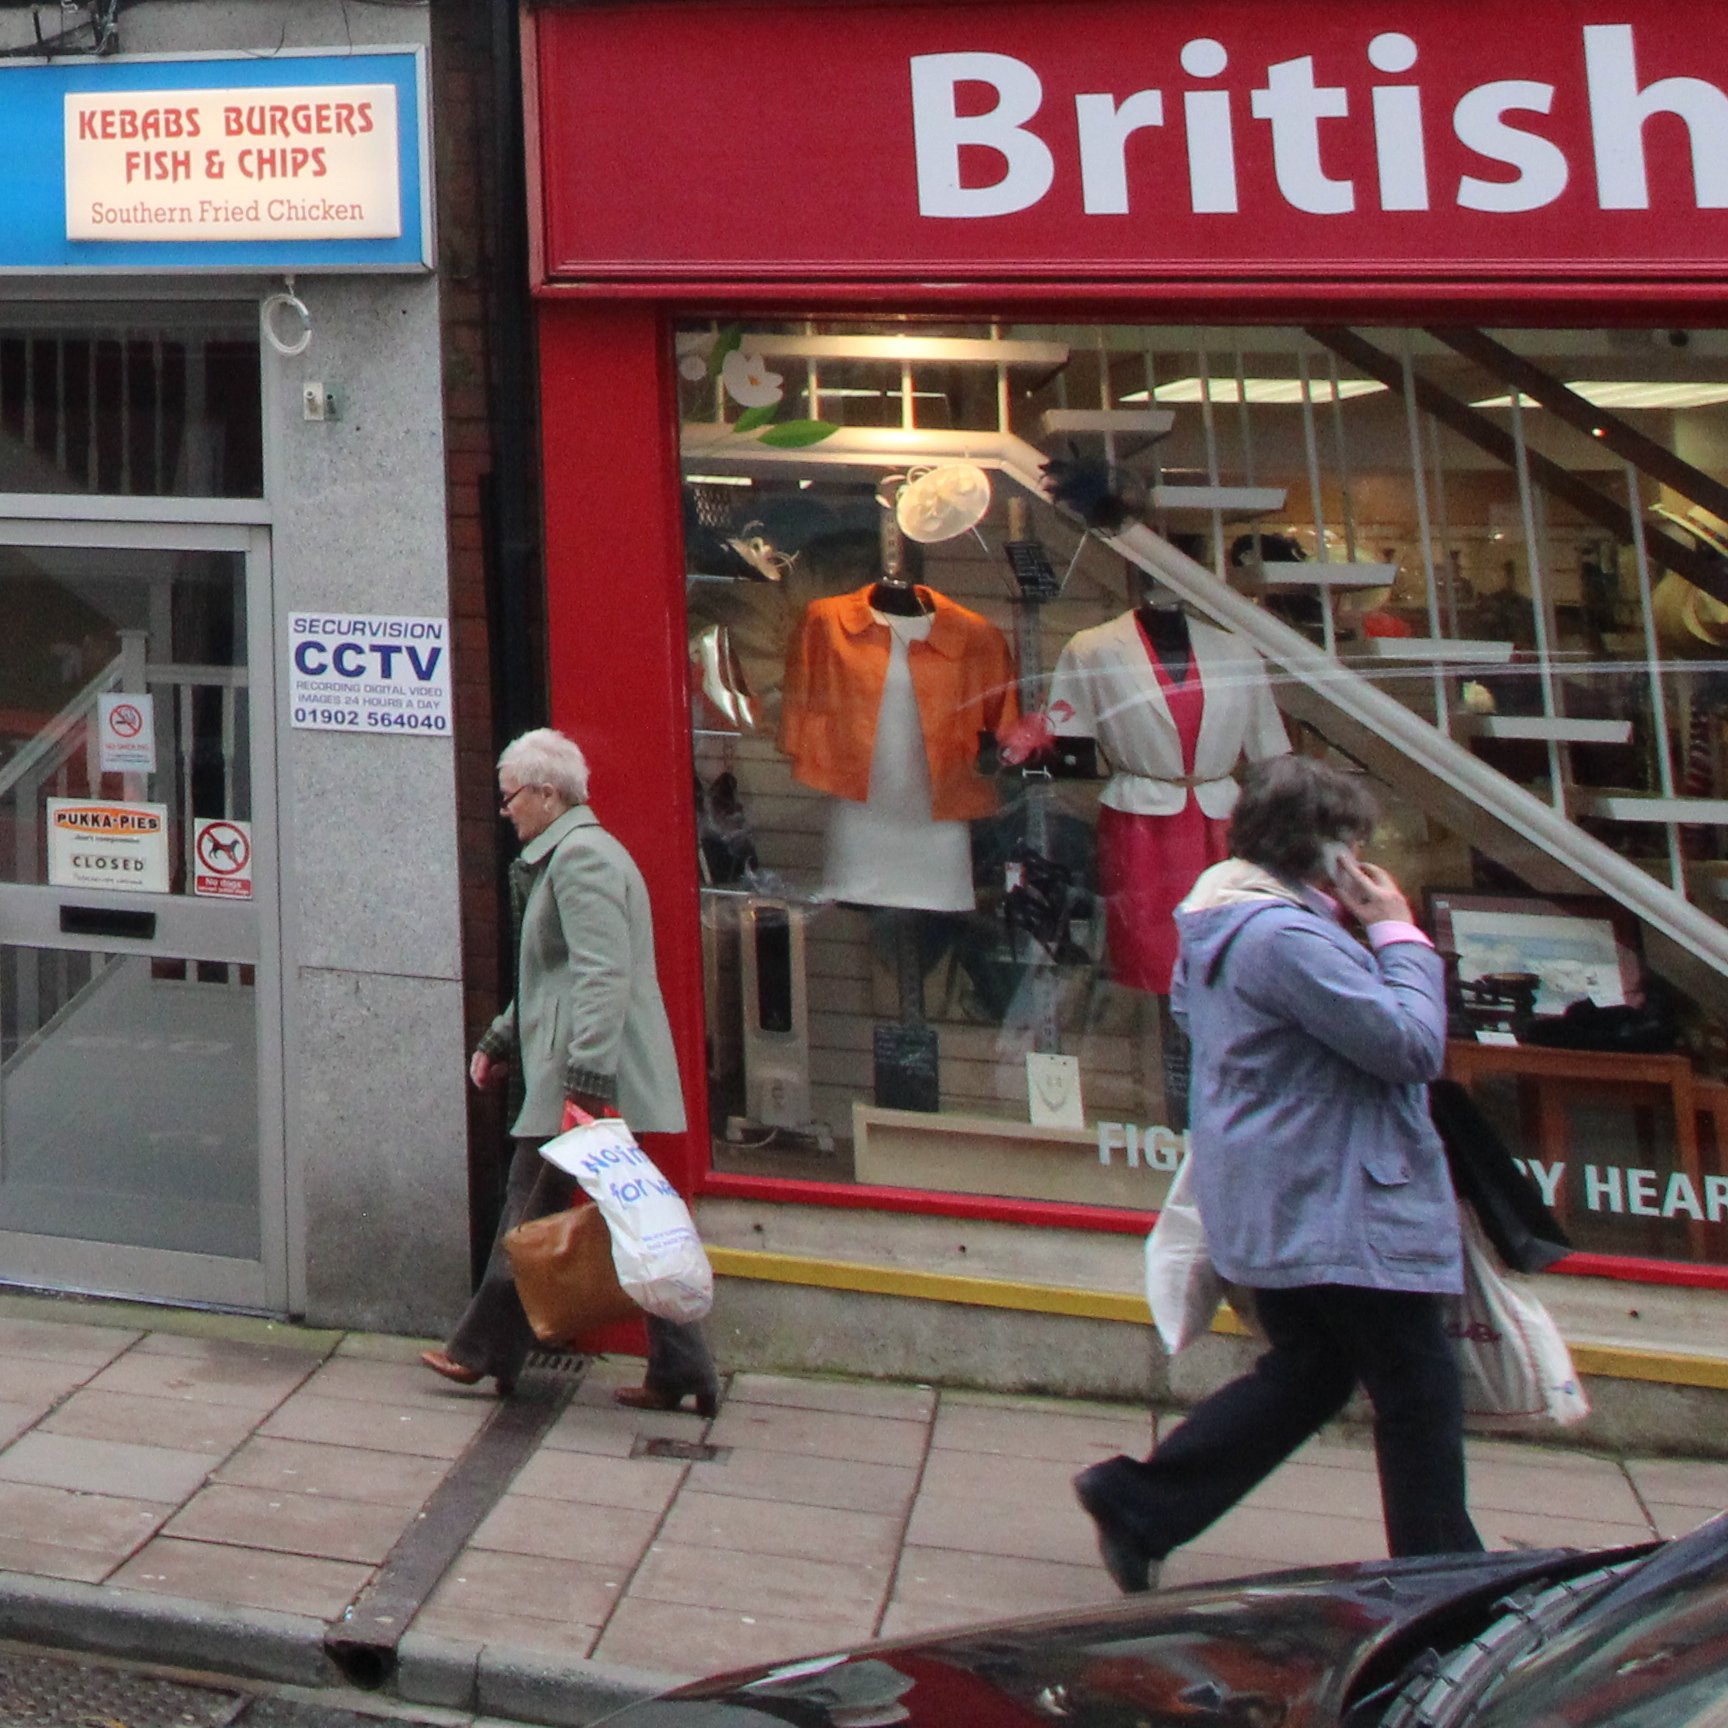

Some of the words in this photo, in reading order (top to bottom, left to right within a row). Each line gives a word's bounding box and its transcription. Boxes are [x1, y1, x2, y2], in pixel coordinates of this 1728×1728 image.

[78, 107, 201, 142] KEBABS
[223, 102, 374, 139] BURGERS
[910, 23, 1728, 218] British
[124, 149, 192, 185] FISH
[204, 148, 225, 180] &
[237, 146, 327, 182] CHIPS
[91, 201, 192, 225] Southern
[198, 199, 260, 223] Fried
[267, 198, 365, 222] Chicken
[293, 617, 443, 640] SECURVISION
[294, 640, 443, 682] CCTV
[296, 680, 361, 694] RECORDING
[363, 684, 406, 697] DIGITAL
[409, 686, 443, 698] VIDEO
[298, 693, 342, 706] IMAGES
[344, 695, 360, 706] 24
[362, 697, 403, 709] HOURS
[405, 698, 415, 709] A
[417, 699, 441, 711] DAY
[294, 707, 360, 726] 01902
[367, 711, 447, 731] 564040
[72, 855, 145, 872] CLOSED
[1584, 1164, 1728, 1223] HEAR
